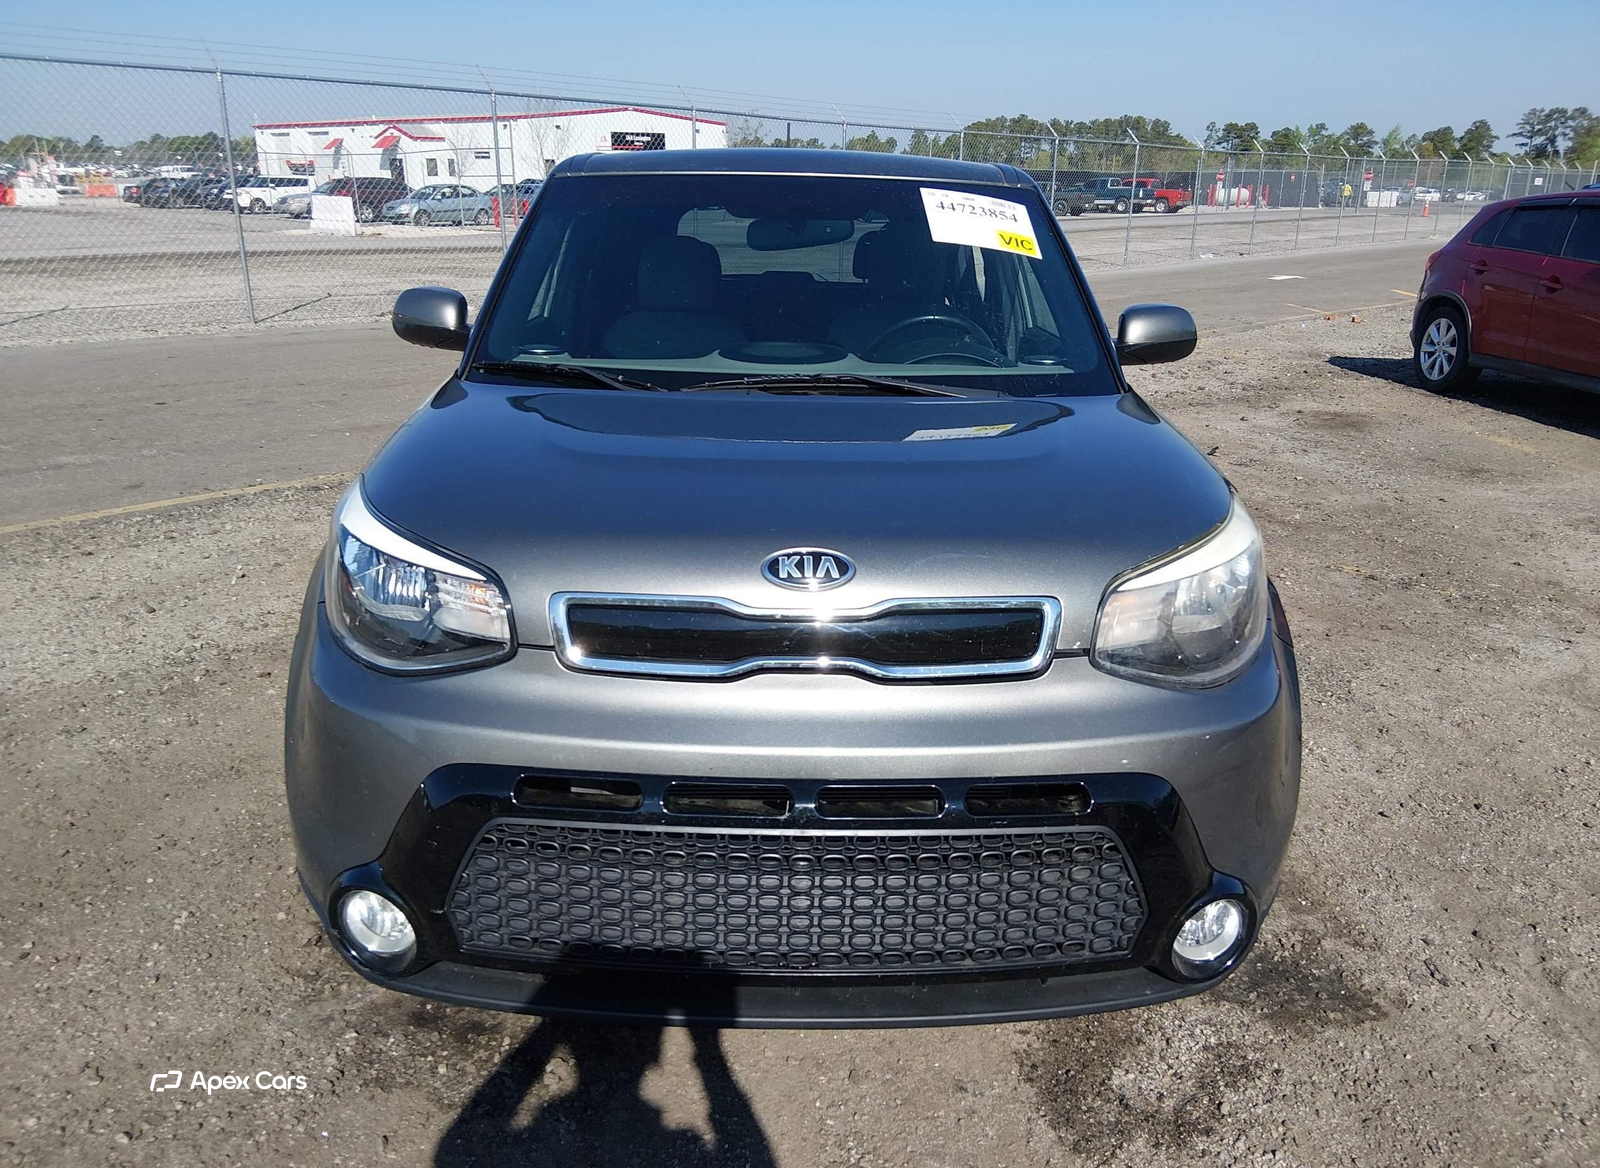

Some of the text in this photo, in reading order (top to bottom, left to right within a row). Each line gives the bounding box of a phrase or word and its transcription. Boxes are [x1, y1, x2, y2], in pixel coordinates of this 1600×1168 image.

[935, 201, 1018, 223] 44723854
[998, 233, 1033, 251] VIC
[778, 555, 840, 579] KIA
